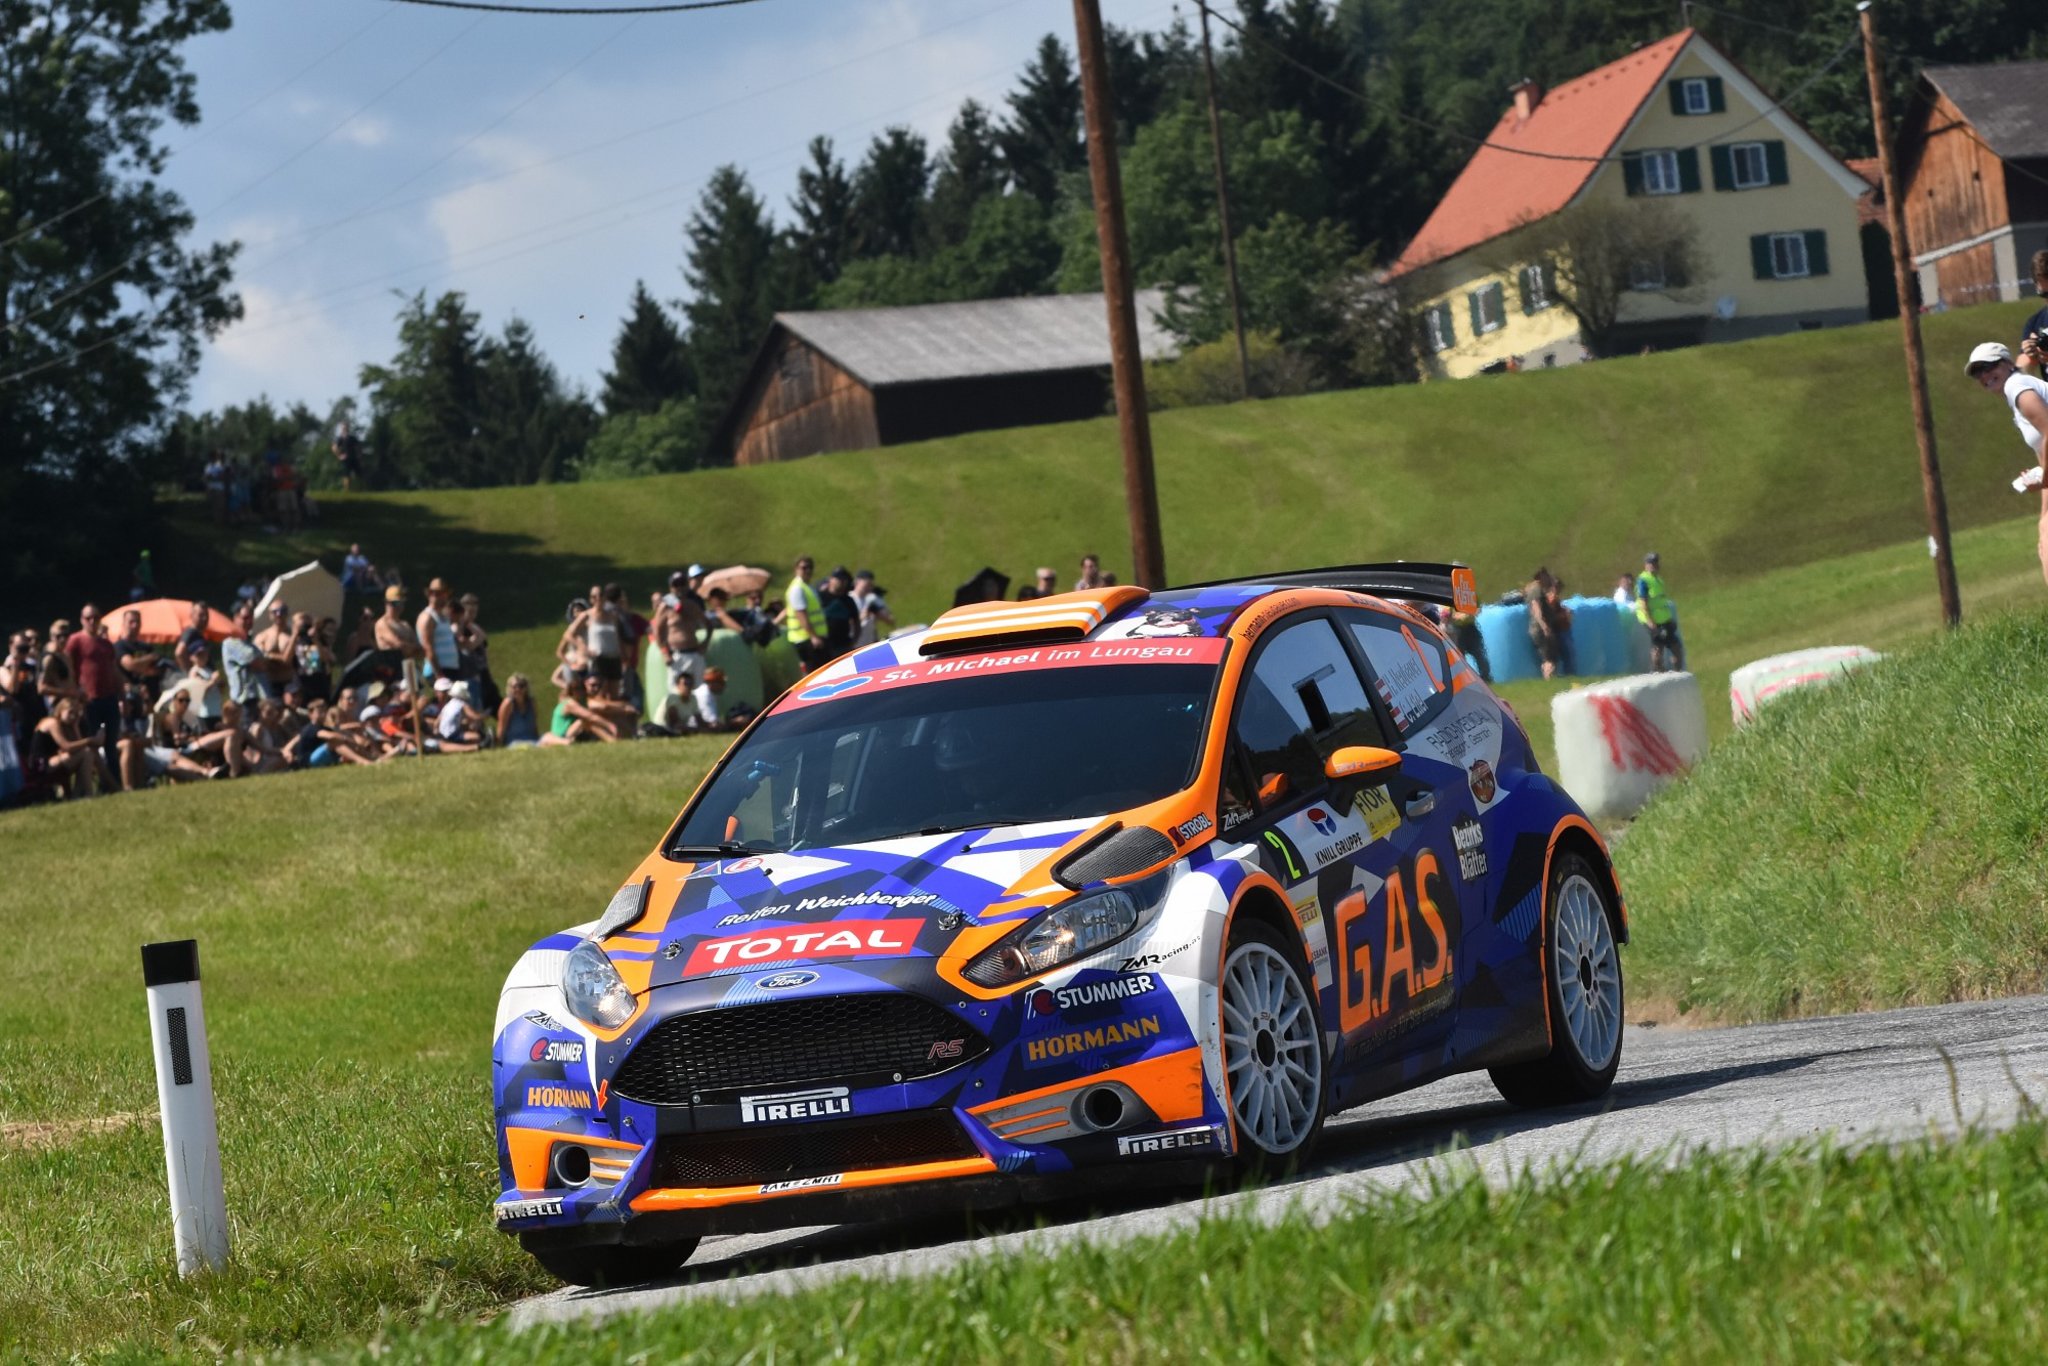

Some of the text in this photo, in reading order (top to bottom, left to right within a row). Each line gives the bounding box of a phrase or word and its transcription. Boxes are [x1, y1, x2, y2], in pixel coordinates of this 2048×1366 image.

[880, 646, 1193, 684] St. Michael im Lungau
[1401, 624, 1446, 693] 2
[1179, 813, 1212, 840] STROBL
[1452, 820, 1484, 850] Bezirks
[1263, 831, 1301, 880] 2
[1315, 832, 1363, 866] KNILL GRUPPE
[1459, 851, 1488, 880] Blätter
[715, 891, 938, 928] Reifen Weichberger
[705, 929, 903, 965] TOTAL
[1335, 848, 1454, 1035] G.A.S.
[768, 974, 804, 988] Ford
[1056, 975, 1154, 1009] STUMMER
[545, 1041, 583, 1062] STUMMER
[927, 1039, 965, 1059] RS
[1028, 1015, 1162, 1062] HÖRMANN
[527, 1085, 592, 1109] HÖRMANN
[740, 1086, 850, 1123] PIRELLI
[1117, 1125, 1212, 1156] PIRELLI
